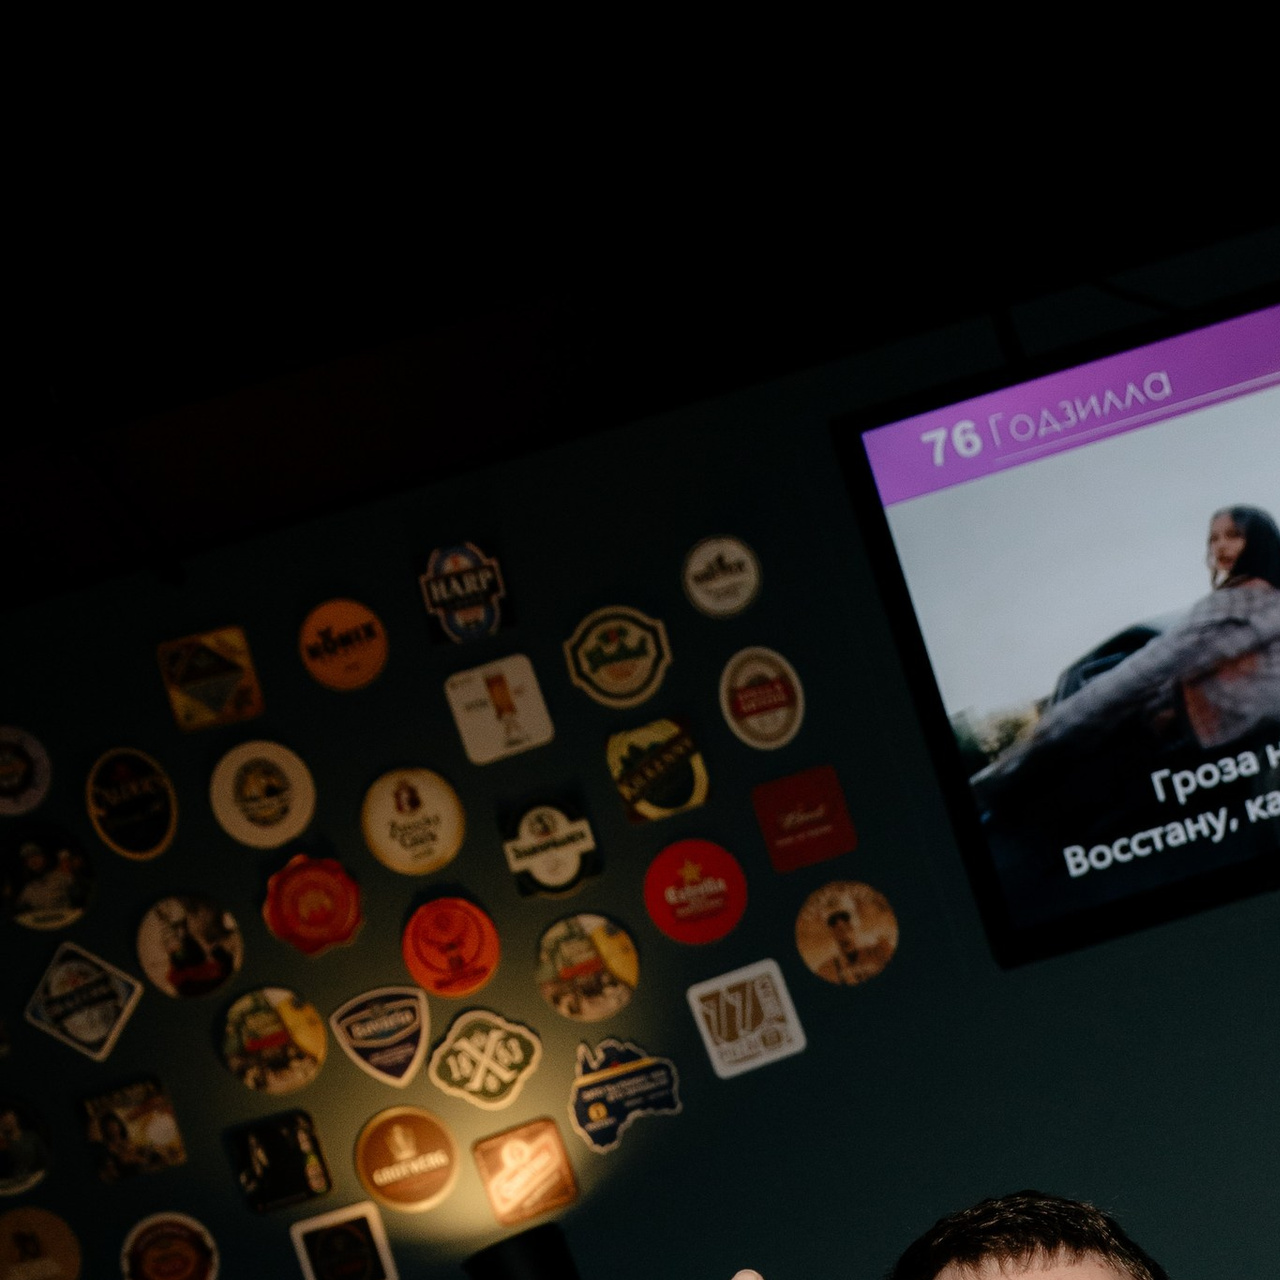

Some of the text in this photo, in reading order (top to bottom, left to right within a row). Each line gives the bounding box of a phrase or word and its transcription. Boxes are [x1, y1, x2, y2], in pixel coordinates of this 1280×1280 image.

[920, 419, 983, 467] 76
[428, 567, 494, 603] HARP
[1151, 750, 1259, 805] Гроза
[1063, 806, 1240, 878] Восстану,
